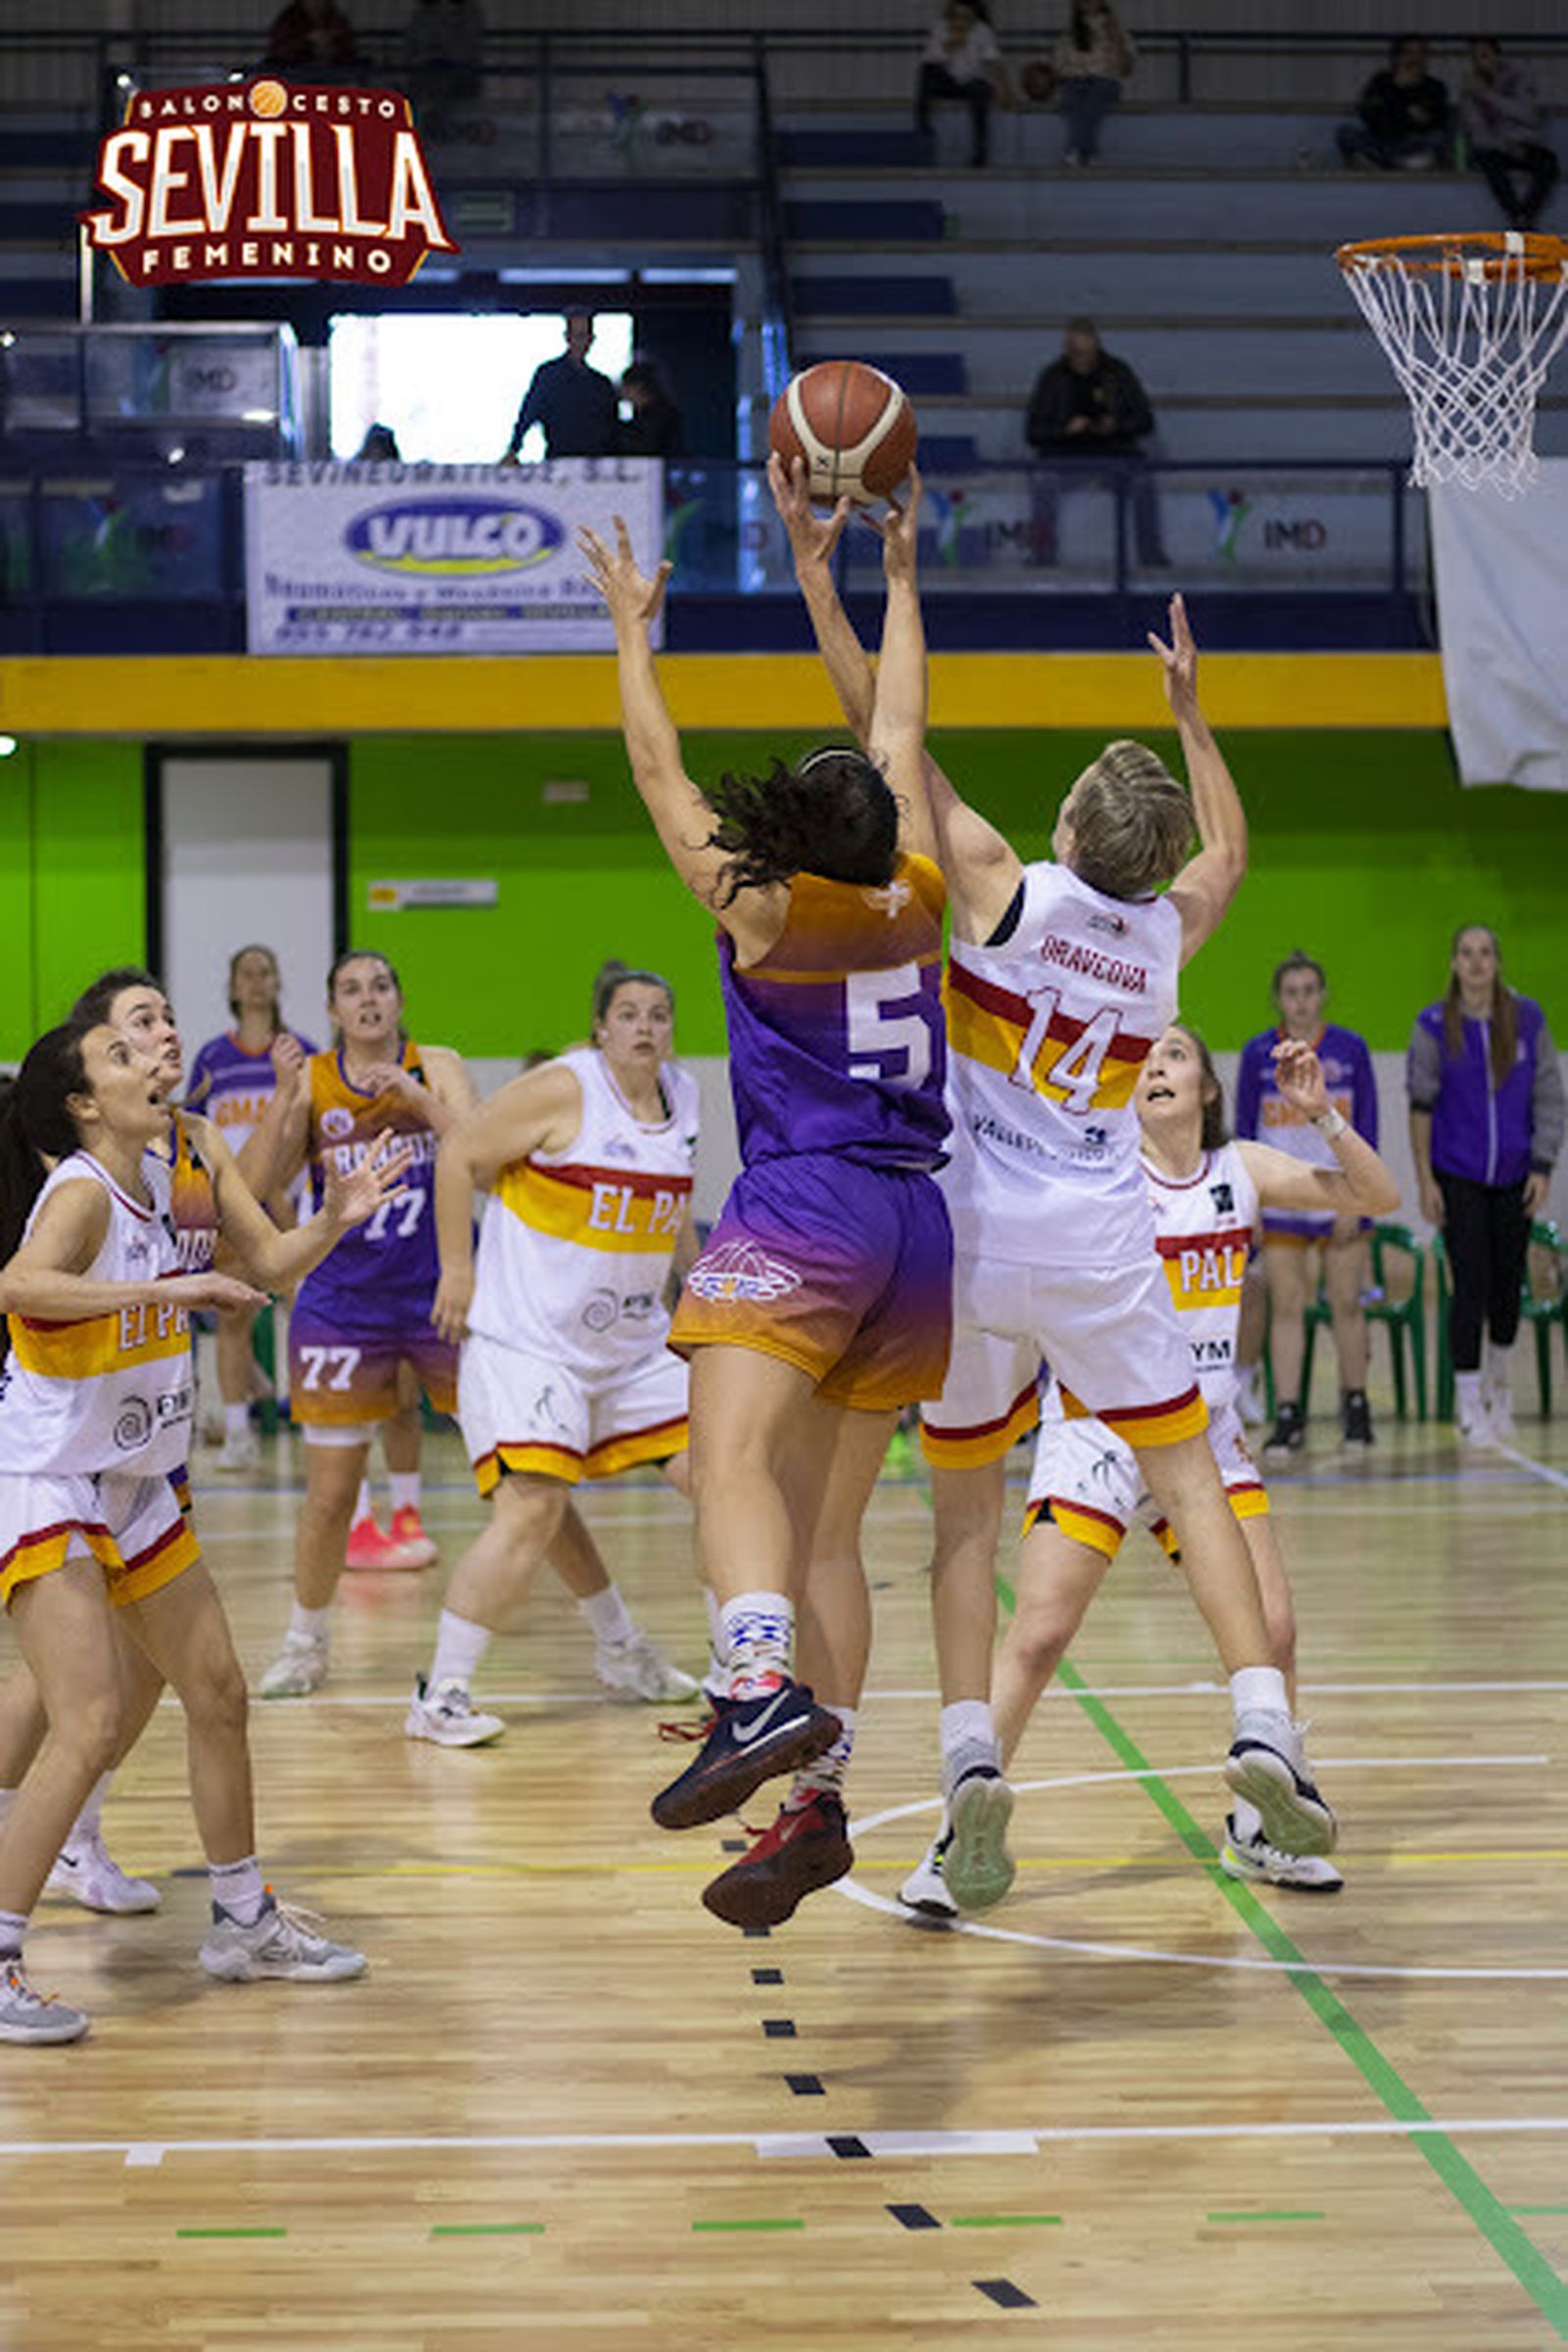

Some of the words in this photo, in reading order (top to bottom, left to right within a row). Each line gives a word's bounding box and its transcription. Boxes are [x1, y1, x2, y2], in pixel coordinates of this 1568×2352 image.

[367, 513, 543, 560] VULCO
[1264, 518, 1327, 551] IMD
[847, 960, 932, 1090] 5
[1008, 985, 1124, 1116] 14
[589, 1182, 636, 1234] EL
[1179, 1244, 1249, 1293] PAL
[299, 1346, 363, 1392] 77
